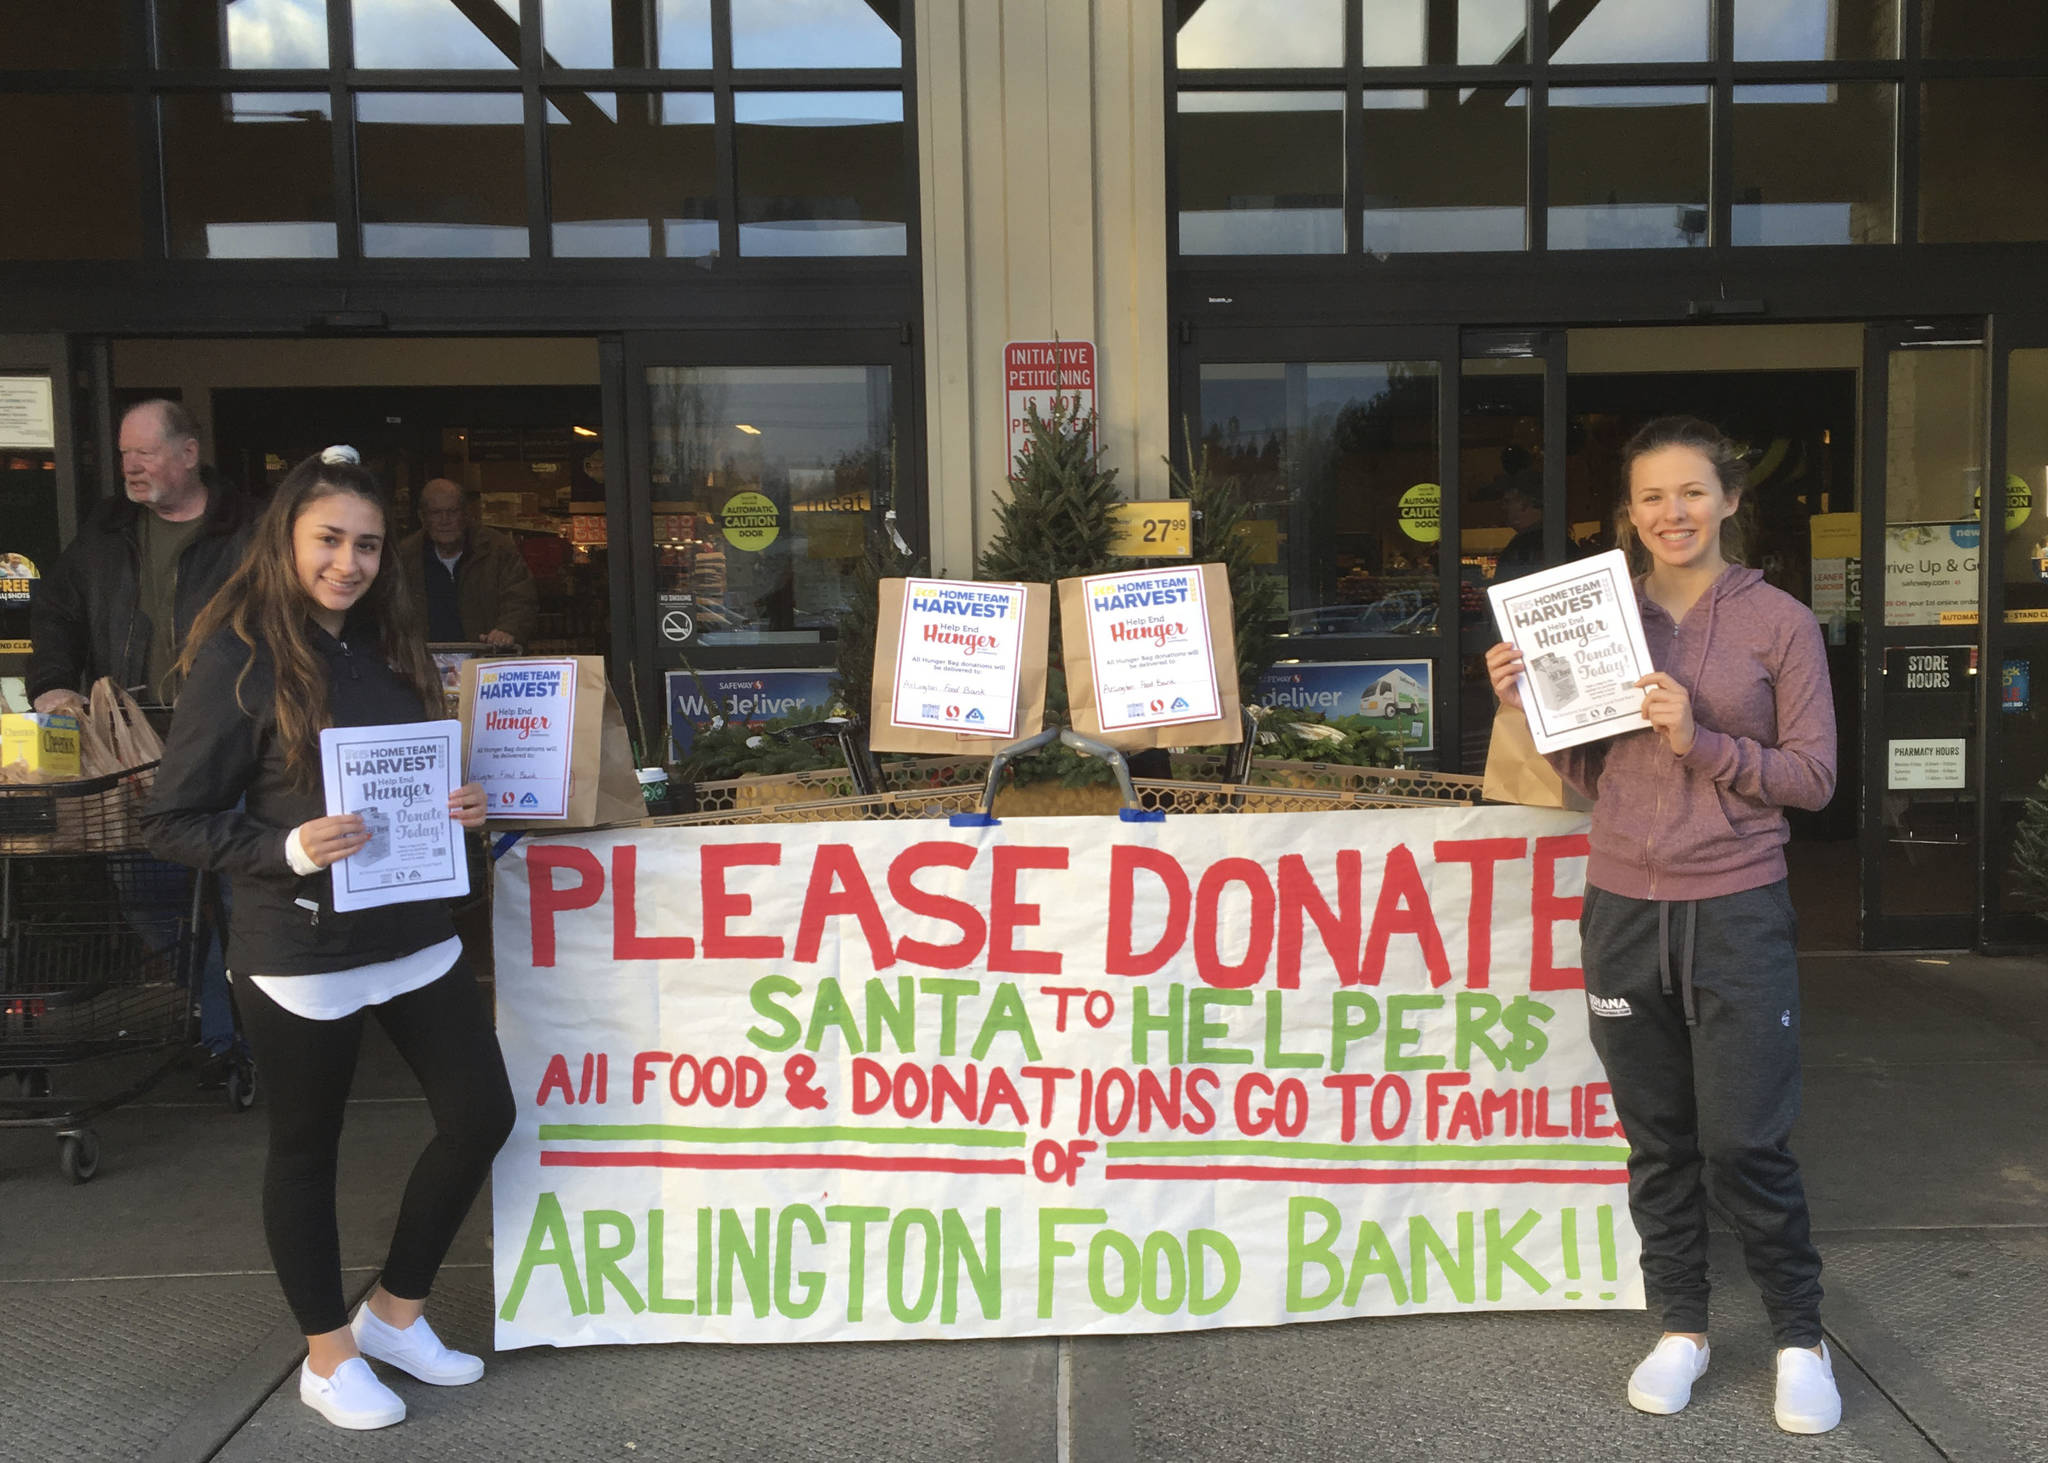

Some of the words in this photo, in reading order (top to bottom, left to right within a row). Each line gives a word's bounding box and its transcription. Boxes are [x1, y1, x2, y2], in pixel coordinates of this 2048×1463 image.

[1010, 370, 1090, 386] PETITIONING
[725, 516, 776, 527] CAUTION
[1885, 561, 1915, 574] rive
[1919, 560, 1942, 576] Up
[1946, 559, 1958, 572] &
[1117, 581, 1153, 593] HOME
[1154, 577, 1188, 589] TEAM
[1534, 589, 1569, 607] HOME
[1568, 579, 1602, 597] TEAM
[939, 590, 975, 601] HOME
[978, 593, 1010, 604] TEAM
[1094, 588, 1188, 612] HARVEST
[913, 598, 1009, 619] HARVEST
[1514, 590, 1604, 629] HARVEST
[940, 623, 960, 632] Help
[962, 625, 979, 633] End
[1126, 617, 1146, 626] Help
[1148, 615, 1165, 623] End
[1547, 621, 1567, 632] Help
[1568, 616, 1585, 626] End
[923, 624, 1000, 656] Hunger
[1110, 621, 1188, 648] Hunger
[1534, 619, 1609, 649] Hunger
[1574, 642, 1625, 664] Donate
[943, 665, 973, 674] delivered
[947, 659, 959, 667] Bag
[961, 661, 993, 669] donations
[1578, 655, 1631, 680] Today!
[1909, 655, 1949, 671] STORE
[498, 671, 529, 682] HOME
[530, 671, 561, 681] TEAM
[719, 681, 753, 690] SAFEWAY
[1907, 672, 1950, 689] HOURS
[480, 681, 560, 700] HARVEST
[944, 683, 961, 694] Food
[1262, 687, 1343, 709] deliver
[498, 707, 516, 717] Help
[517, 707, 533, 715] End
[727, 693, 805, 716] deliver
[485, 711, 552, 740] Hunger
[370, 746, 405, 758] HOME
[406, 744, 437, 755] TEAM
[1894, 747, 1934, 757] PHARMACY
[1936, 747, 1960, 756] HOURS
[345, 755, 437, 777] HARVEST
[377, 777, 398, 787] Help
[398, 776, 414, 784] End
[362, 781, 434, 808] Hunger
[395, 807, 442, 823] Donate
[395, 822, 444, 843] Today!
[527, 841, 1069, 974] PLEASE
[1106, 834, 1591, 991] DONATE
[746, 975, 1042, 1061] SANTA
[1041, 987, 1114, 1032] TO
[1132, 984, 1555, 1073] HELPER$
[633, 1051, 767, 1107] FOOD
[785, 1056, 828, 1109] &
[852, 1058, 1220, 1135] DONATIONS
[1234, 1072, 1309, 1137] GO
[1323, 1073, 1412, 1143] TO
[1426, 1072, 1628, 1141] FAMILIE
[1032, 1139, 1098, 1186] OF
[499, 1191, 1001, 1324] ARLINGTON
[1037, 1207, 1241, 1319] FOOD
[1286, 1196, 1618, 1313] BANK!!
